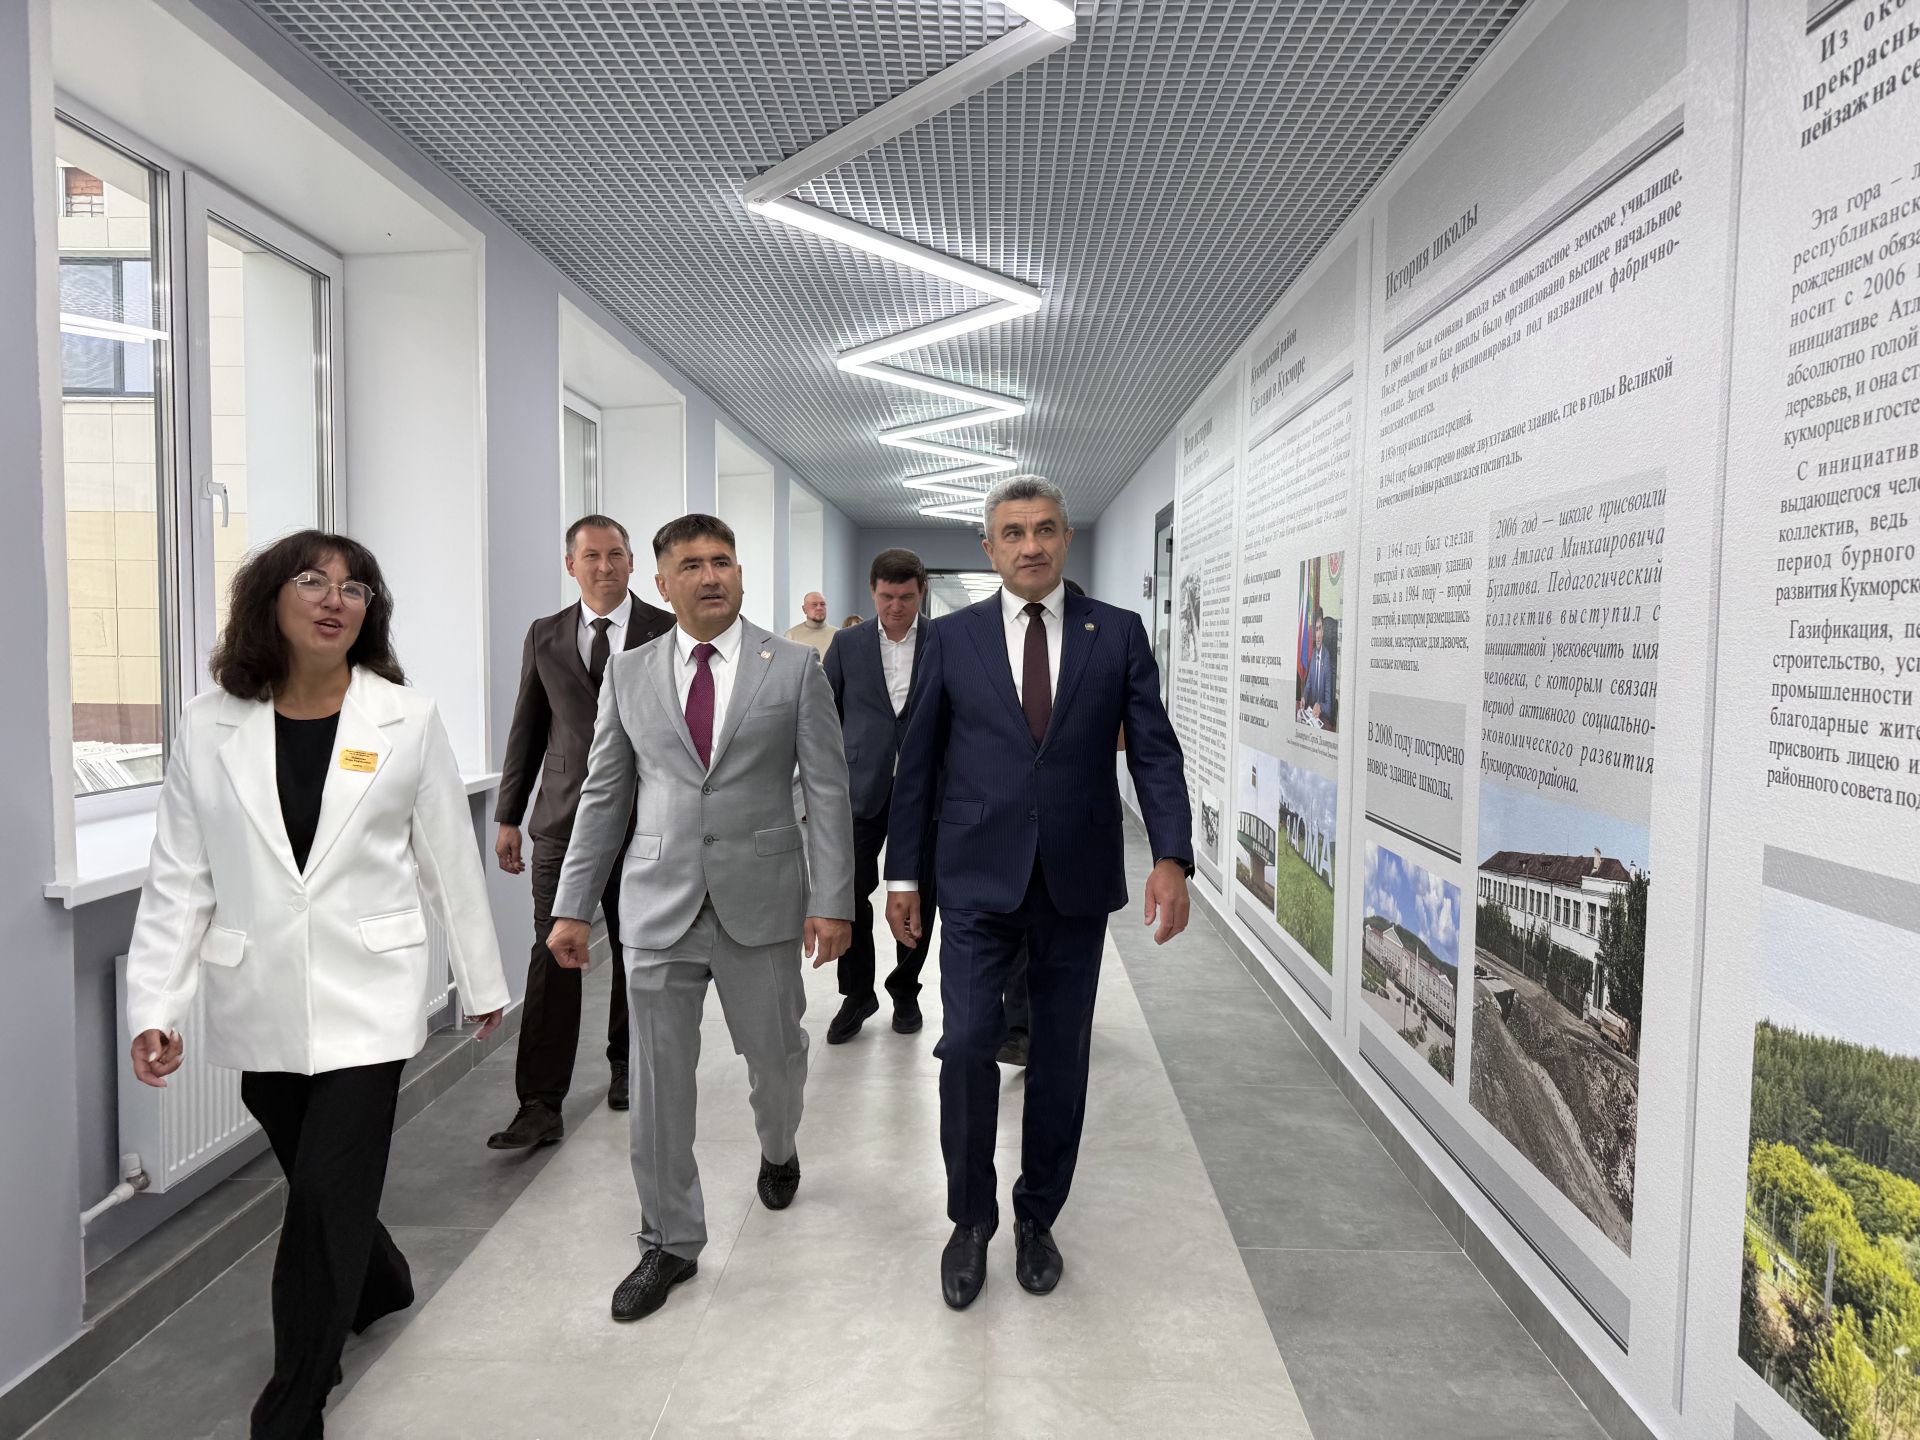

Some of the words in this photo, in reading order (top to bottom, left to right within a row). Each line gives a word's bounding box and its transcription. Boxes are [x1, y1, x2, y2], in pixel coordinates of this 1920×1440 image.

[1820, 28, 1848, 64] Из
[1801, 91, 1869, 149] пейзаж
[1872, 75, 1896, 104] на
[1811, 205, 1838, 230] Эта
[1847, 183, 1881, 213] гора
[1386, 247, 1429, 301] История
[1433, 202, 1478, 261] школы
[1417, 339, 1432, 356] была
[1435, 317, 1463, 344] основана
[1466, 300, 1488, 324] школа
[1492, 287, 1506, 302] как
[1510, 244, 1570, 296] одноклассное
[1575, 211, 1616, 252] земское
[1621, 168, 1682, 226] училище.
[1791, 298, 1835, 328] носит
[1845, 291, 1853, 306] с
[1864, 262, 1906, 299] 2006
[1792, 250, 1874, 304] рождением
[1398, 362, 1428, 394] революции
[1430, 356, 1437, 369] на
[1440, 347, 1453, 363] базе
[1455, 329, 1480, 354] школы
[1482, 316, 1501, 337] было
[1505, 276, 1564, 326] организовано
[1569, 246, 1610, 284] высшее
[1615, 201, 1681, 255] начальное
[1427, 372, 1448, 392] школа
[1451, 330, 1520, 382] функционировала
[1526, 314, 1542, 338] под
[1547, 280, 1603, 324] названием
[1609, 239, 1679, 293] фабрично-
[1789, 313, 1878, 357] инициативе
[1787, 350, 1865, 387] абсолютно
[1871, 325, 1918, 360] голой
[1278, 356, 1305, 396] Кукморе
[1786, 386, 1851, 418] деревьев,
[1856, 381, 1865, 396] и
[1869, 371, 1897, 393] она
[1424, 452, 1455, 472] построено
[1456, 442, 1476, 460] новое
[1476, 421, 1526, 453] двухэтажное
[1528, 409, 1560, 432] здание,
[1563, 400, 1578, 418] где
[1580, 397, 1586, 411] в
[1588, 384, 1616, 408] годы
[1618, 355, 1673, 397] Великой
[1428, 427, 1444, 443] стала
[1445, 410, 1473, 436] средней.
[1784, 414, 1860, 449] кукморцев
[1864, 410, 1873, 426] и
[1876, 397, 1920, 423] госте
[1414, 478, 1433, 496] войны
[1435, 464, 1479, 494] располагался
[1481, 450, 1522, 476] госпиталь.
[1797, 461, 1808, 480] С
[1818, 443, 1918, 477] инициатив
[1496, 516, 1518, 539] 2006
[1522, 512, 1538, 533] год
[1559, 504, 1593, 526] школе
[1599, 488, 1666, 523] присвоили
[1780, 483, 1881, 514] выдающегося
[1388, 542, 1402, 559] 1964
[1406, 542, 1421, 557] году
[1426, 535, 1440, 551] был
[1445, 531, 1473, 548] сделан
[1779, 519, 1859, 542] коллектив,
[1870, 512, 1908, 531] ведь
[1488, 553, 1506, 569] имя
[1512, 546, 1553, 566] Атласа
[1560, 527, 1665, 558] Минхаировича
[1777, 553, 1831, 576] период
[1842, 544, 1915, 570] бурного
[1407, 562, 1442, 579] основному
[1446, 557, 1472, 574] зданию
[1487, 578, 1540, 602] Булатова.
[1548, 558, 1662, 592] Педагогический
[1406, 586, 1419, 601] 1984
[1422, 588, 1436, 604] году
[1447, 579, 1471, 601] второй
[1776, 583, 1837, 606] развития
[1426, 610, 1470, 628] размещались
[1486, 609, 1553, 627] коллектив
[1560, 605, 1641, 629] выступил
[1653, 604, 1661, 621] с
[1790, 618, 1893, 644] Газификация,
[1440, 637, 1469, 652] девочек,
[1485, 636, 1547, 661] инициативой
[1550, 642, 1625, 663] увековечить
[1632, 642, 1659, 660] имя
[1773, 654, 1885, 675] строительство,
[1484, 671, 1528, 689] человека,
[1535, 673, 1541, 688] с
[1547, 675, 1603, 697] которым
[1610, 678, 1658, 698] связан
[1772, 683, 1912, 706] промышленности
[1482, 696, 1514, 718] период
[1519, 704, 1575, 724] активного
[1582, 711, 1656, 735] социально-
[1770, 707, 1869, 737] благодарные
[1368, 721, 1373, 741] В
[1375, 723, 1393, 747] 2008
[1394, 733, 1413, 757] году
[1415, 738, 1464, 765] построено
[1482, 728, 1573, 758] экономического
[1579, 745, 1655, 774] развития
[1769, 740, 1839, 763] присвоить
[1846, 750, 1899, 771] лицею
[1367, 757, 1387, 777] новое
[1390, 765, 1417, 788] здание
[1419, 774, 1453, 800] школы.
[1480, 751, 1538, 782] Кукморского
[1538, 766, 1579, 793] района.
[1766, 767, 1838, 793] районного
[1841, 781, 1892, 803] совета
